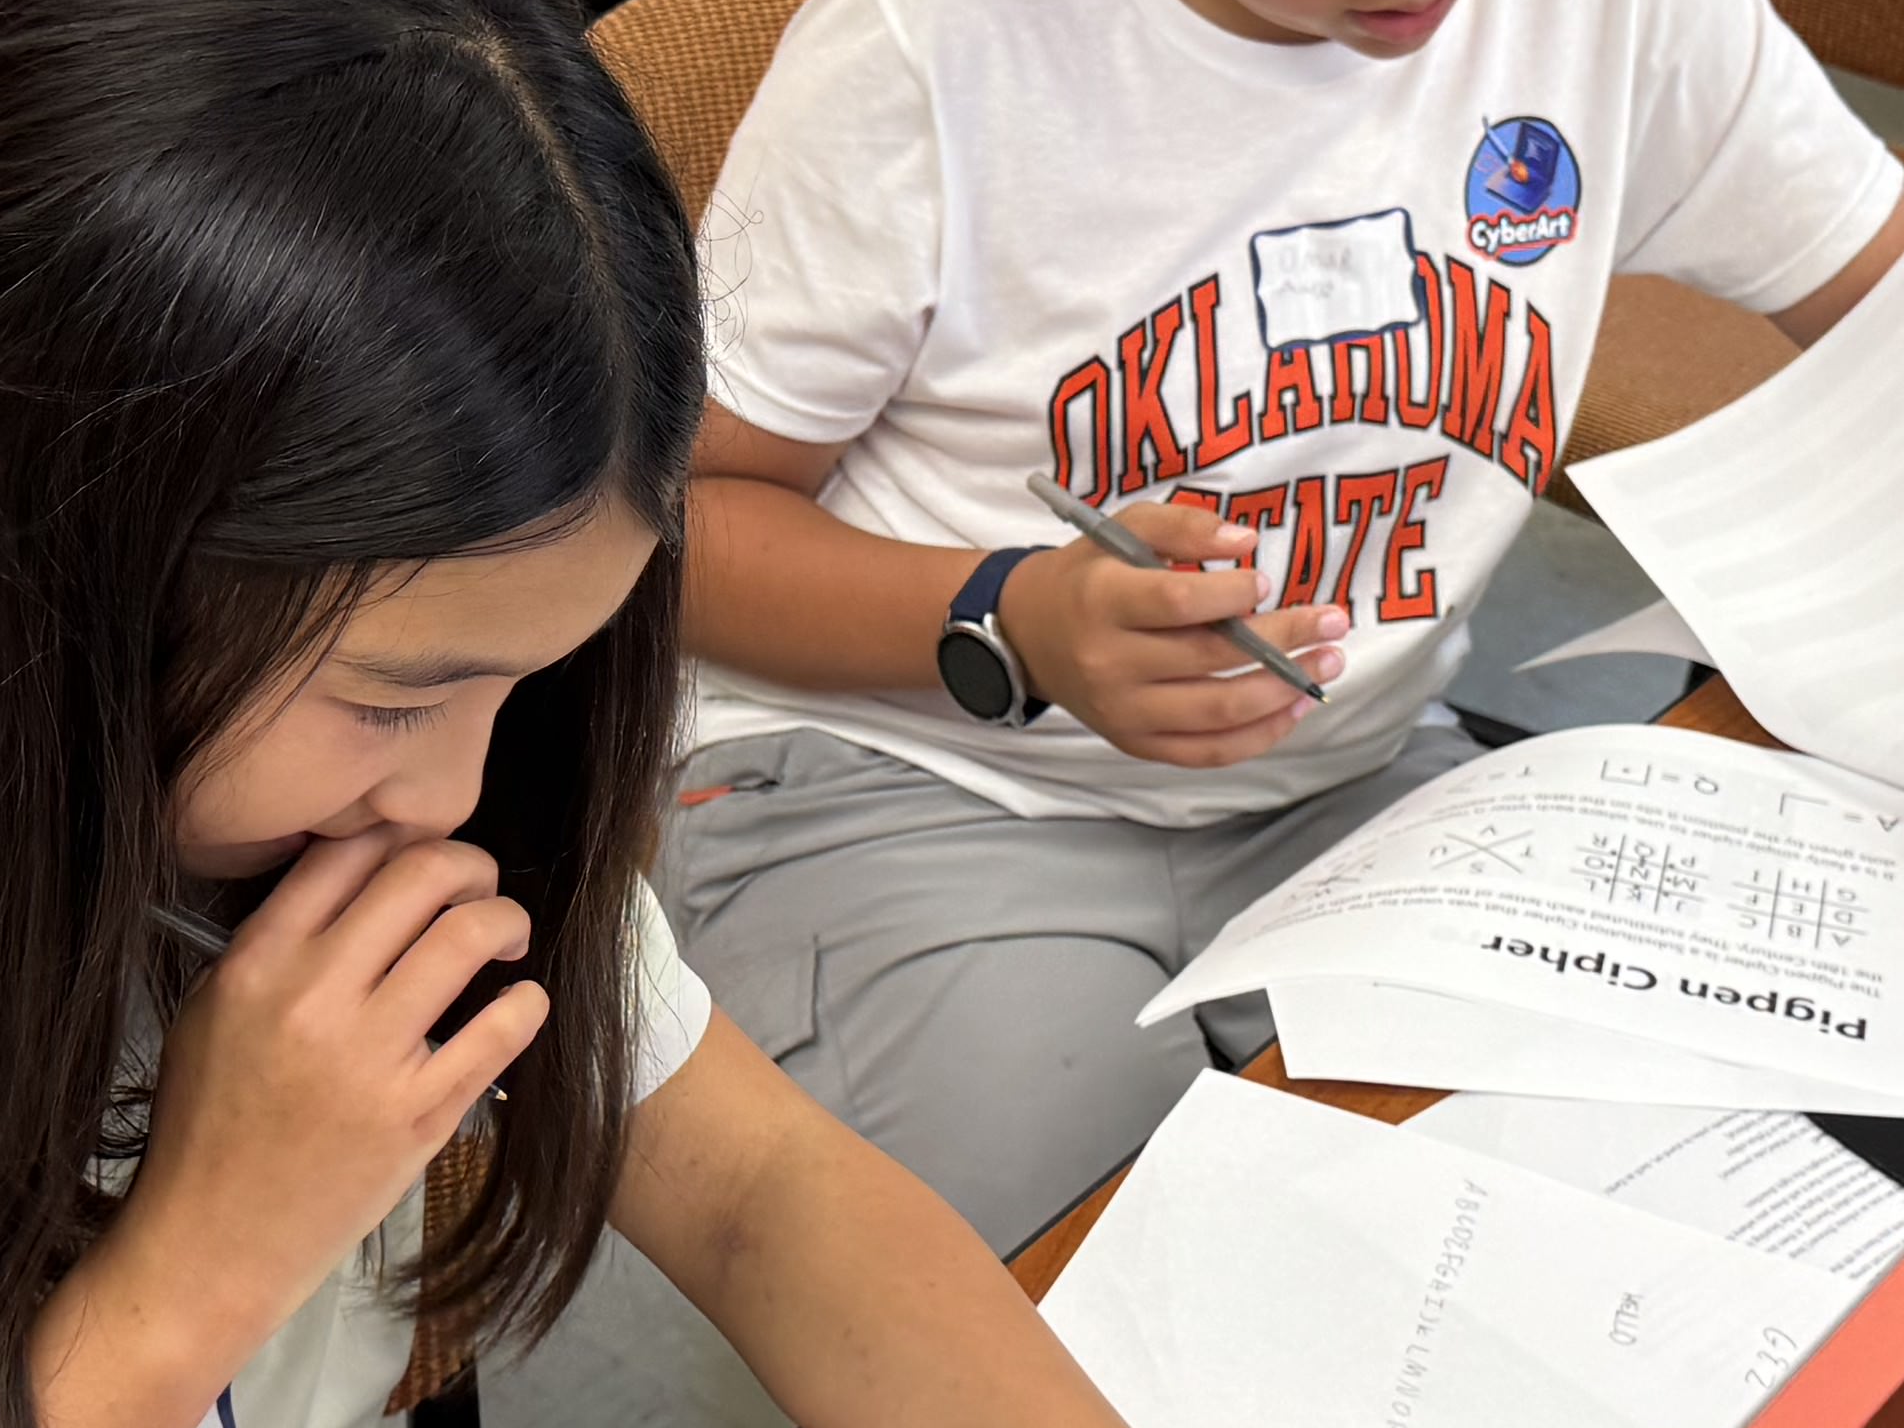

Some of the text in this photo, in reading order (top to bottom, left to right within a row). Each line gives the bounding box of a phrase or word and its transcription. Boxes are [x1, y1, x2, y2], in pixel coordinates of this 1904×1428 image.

[1468, 214, 1573, 254] CyberArt
[1482, 936, 1867, 1040] Pigpen Cipher
